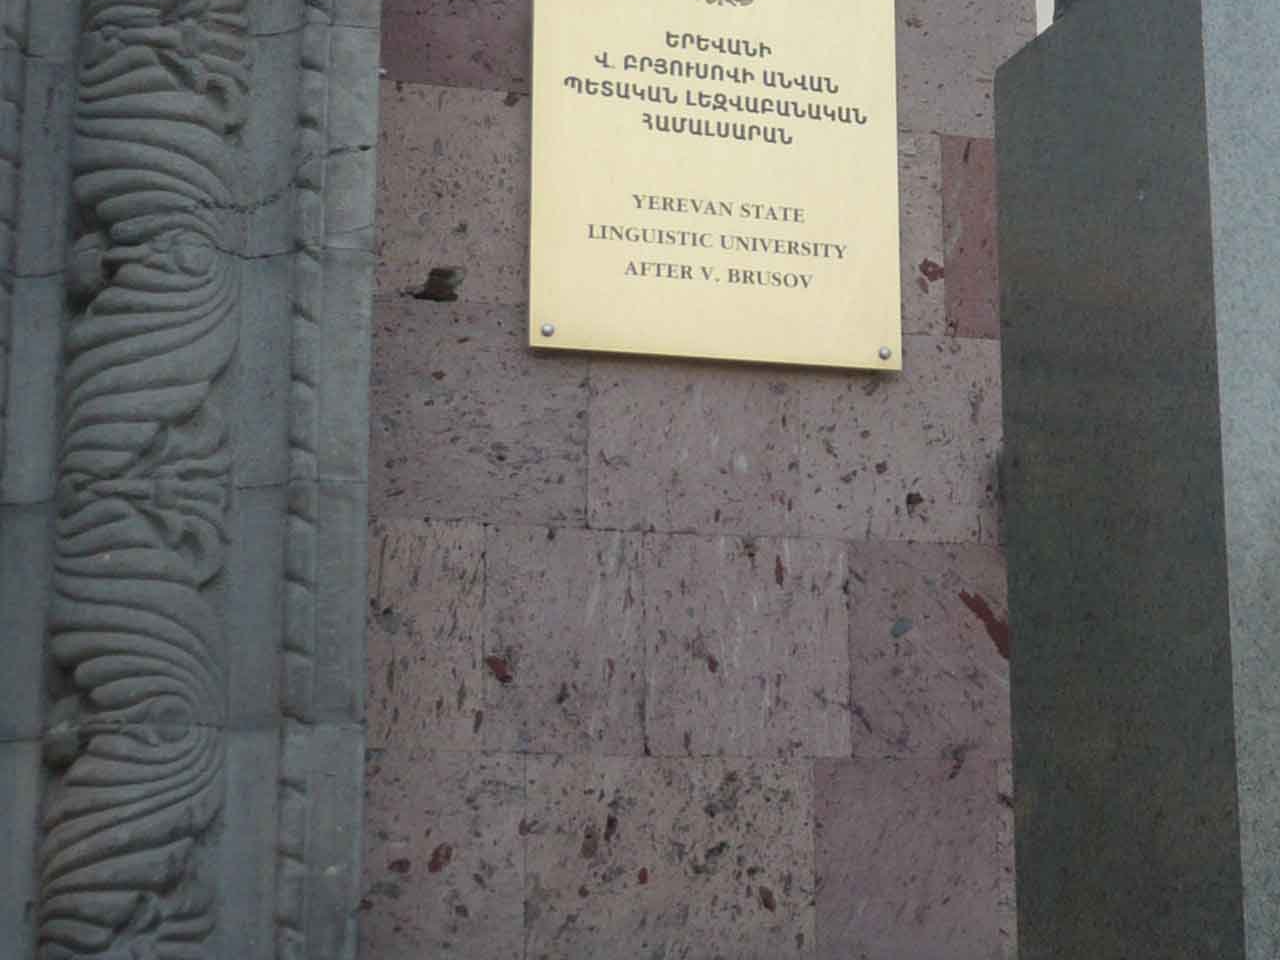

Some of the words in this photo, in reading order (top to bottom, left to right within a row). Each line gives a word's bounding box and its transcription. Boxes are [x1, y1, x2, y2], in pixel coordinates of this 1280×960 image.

[665, 31, 772, 58] ԵՐԵՎԱՆԻ
[624, 54, 755, 84] ԲՐՅՈՒՍՈՎԻ
[762, 69, 839, 95] ԱՆՎԱՆ
[563, 75, 678, 105] ՊԵՏԱԿԱՆ
[686, 89, 868, 125] ԼԵԶՎԱԲԱՆԱԿԱՆ
[641, 112, 793, 145] ՀԱՄԱԼՍԱՐԱՆ
[632, 194, 734, 217] YEREVAN
[739, 202, 806, 223] STATE
[587, 223, 713, 249] LINGUISTIC
[719, 234, 848, 260] UNIVERSITY
[624, 260, 694, 281] AFTER
[700, 266, 721, 283] V.
[727, 268, 814, 289] BRUSOV
